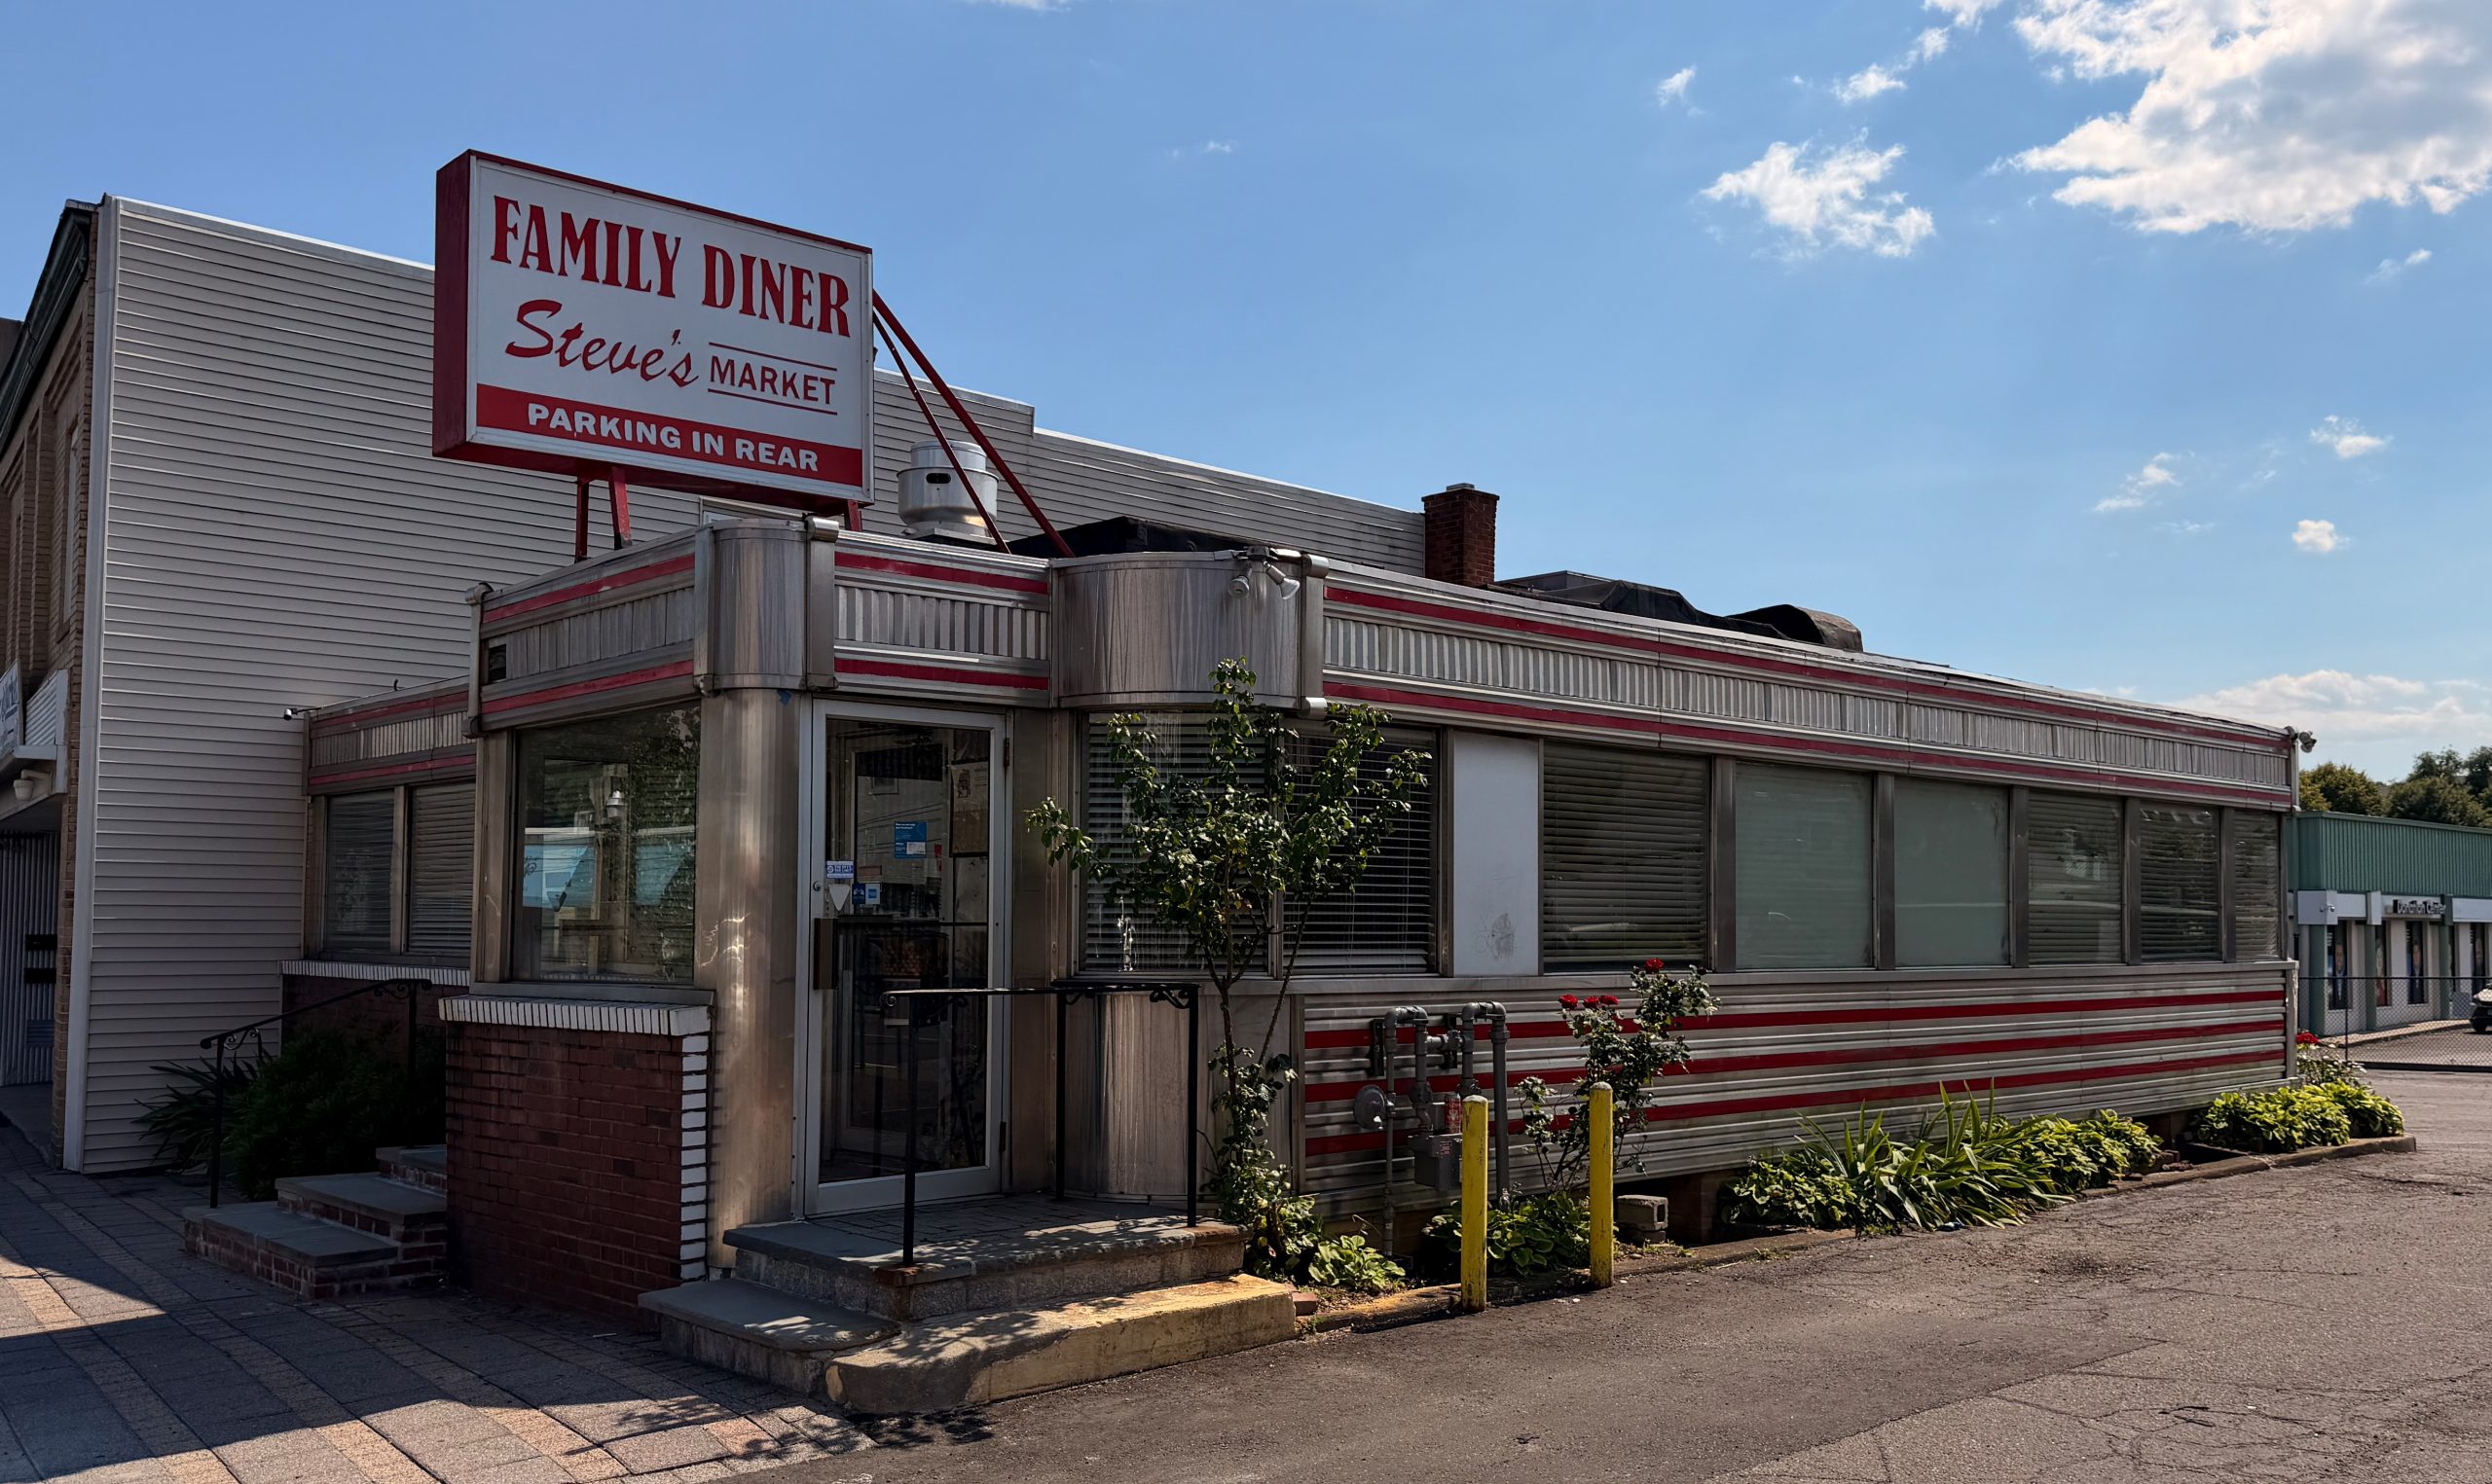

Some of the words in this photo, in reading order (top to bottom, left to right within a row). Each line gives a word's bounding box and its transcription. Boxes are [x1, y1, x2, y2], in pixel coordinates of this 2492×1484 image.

[491, 195, 681, 298] FAMILY
[702, 243, 851, 338] DINER
[505, 299, 699, 387] Steve's
[710, 355, 836, 405] MARKET
[528, 402, 681, 450] PARKING
[692, 431, 724, 456] IN
[735, 437, 819, 472] REAR
